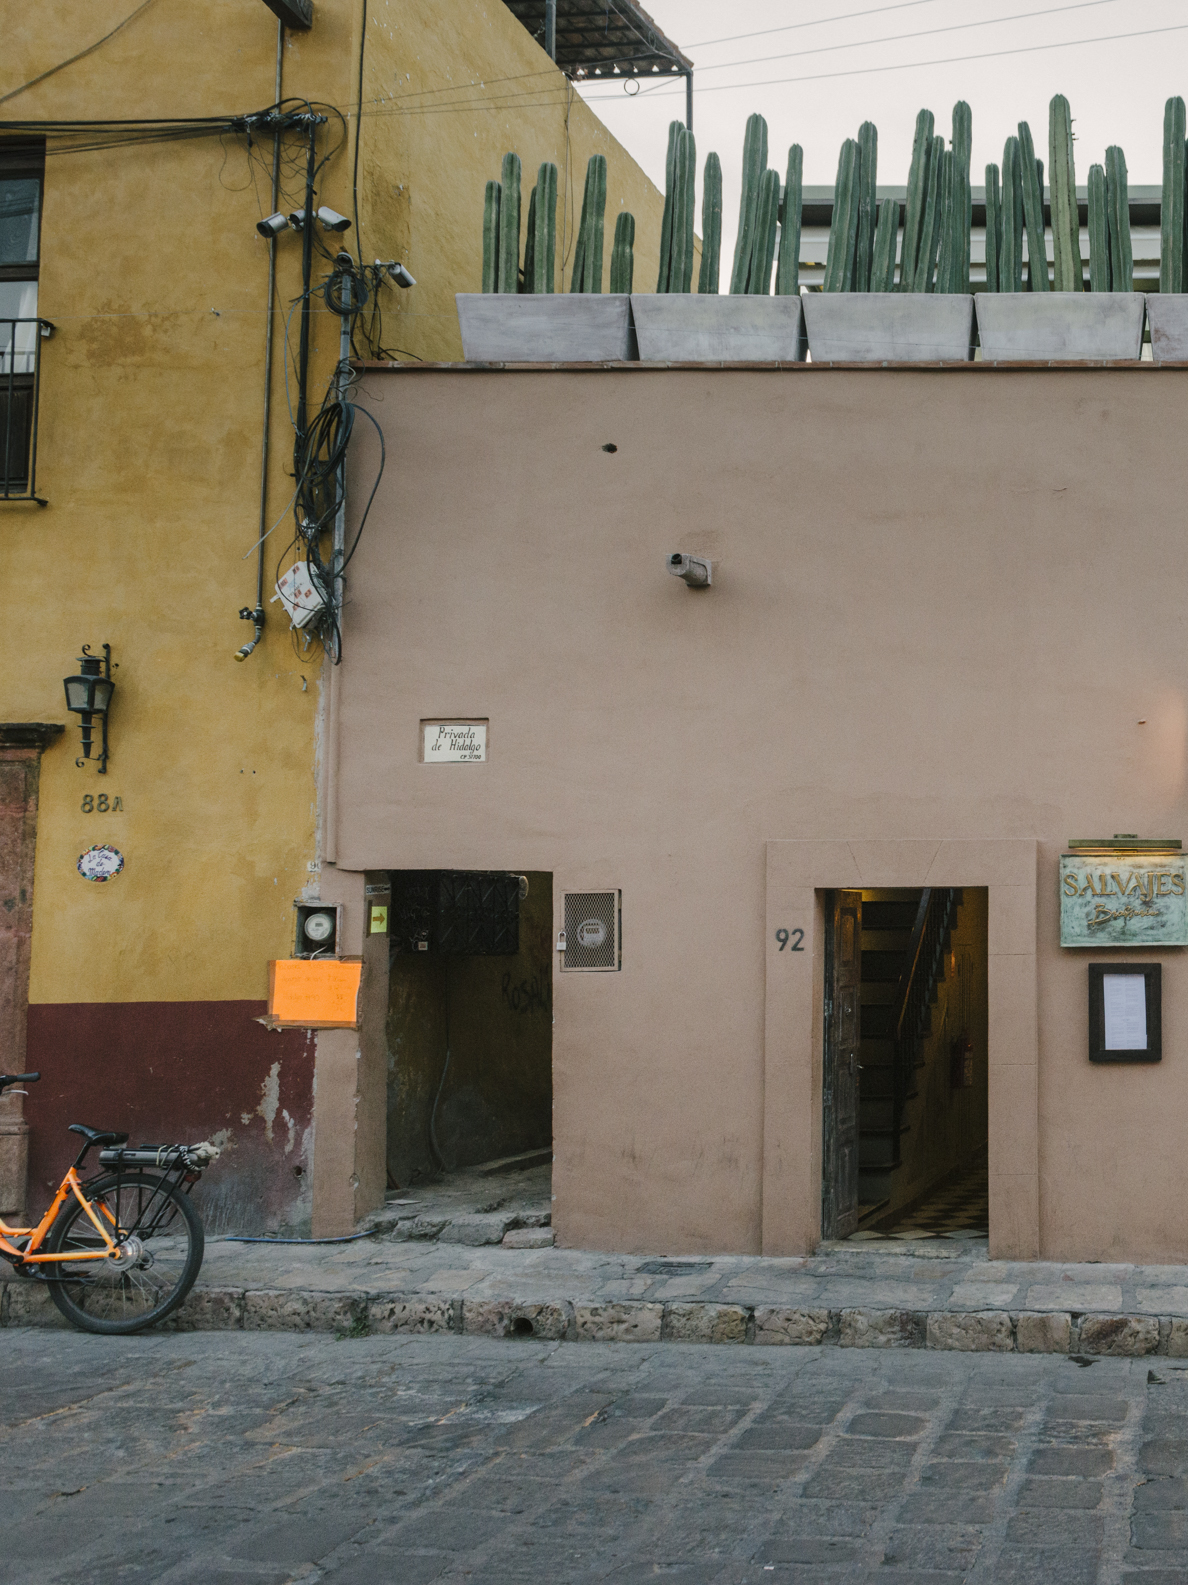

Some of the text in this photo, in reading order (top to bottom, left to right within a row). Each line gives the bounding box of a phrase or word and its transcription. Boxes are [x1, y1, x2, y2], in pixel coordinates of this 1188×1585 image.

[438, 726, 476, 739] Privada
[431, 739, 482, 754] de Hidalgo
[81, 793, 124, 813] 88A
[1063, 872, 1185, 902] SALVAJES
[775, 928, 805, 951] 92
